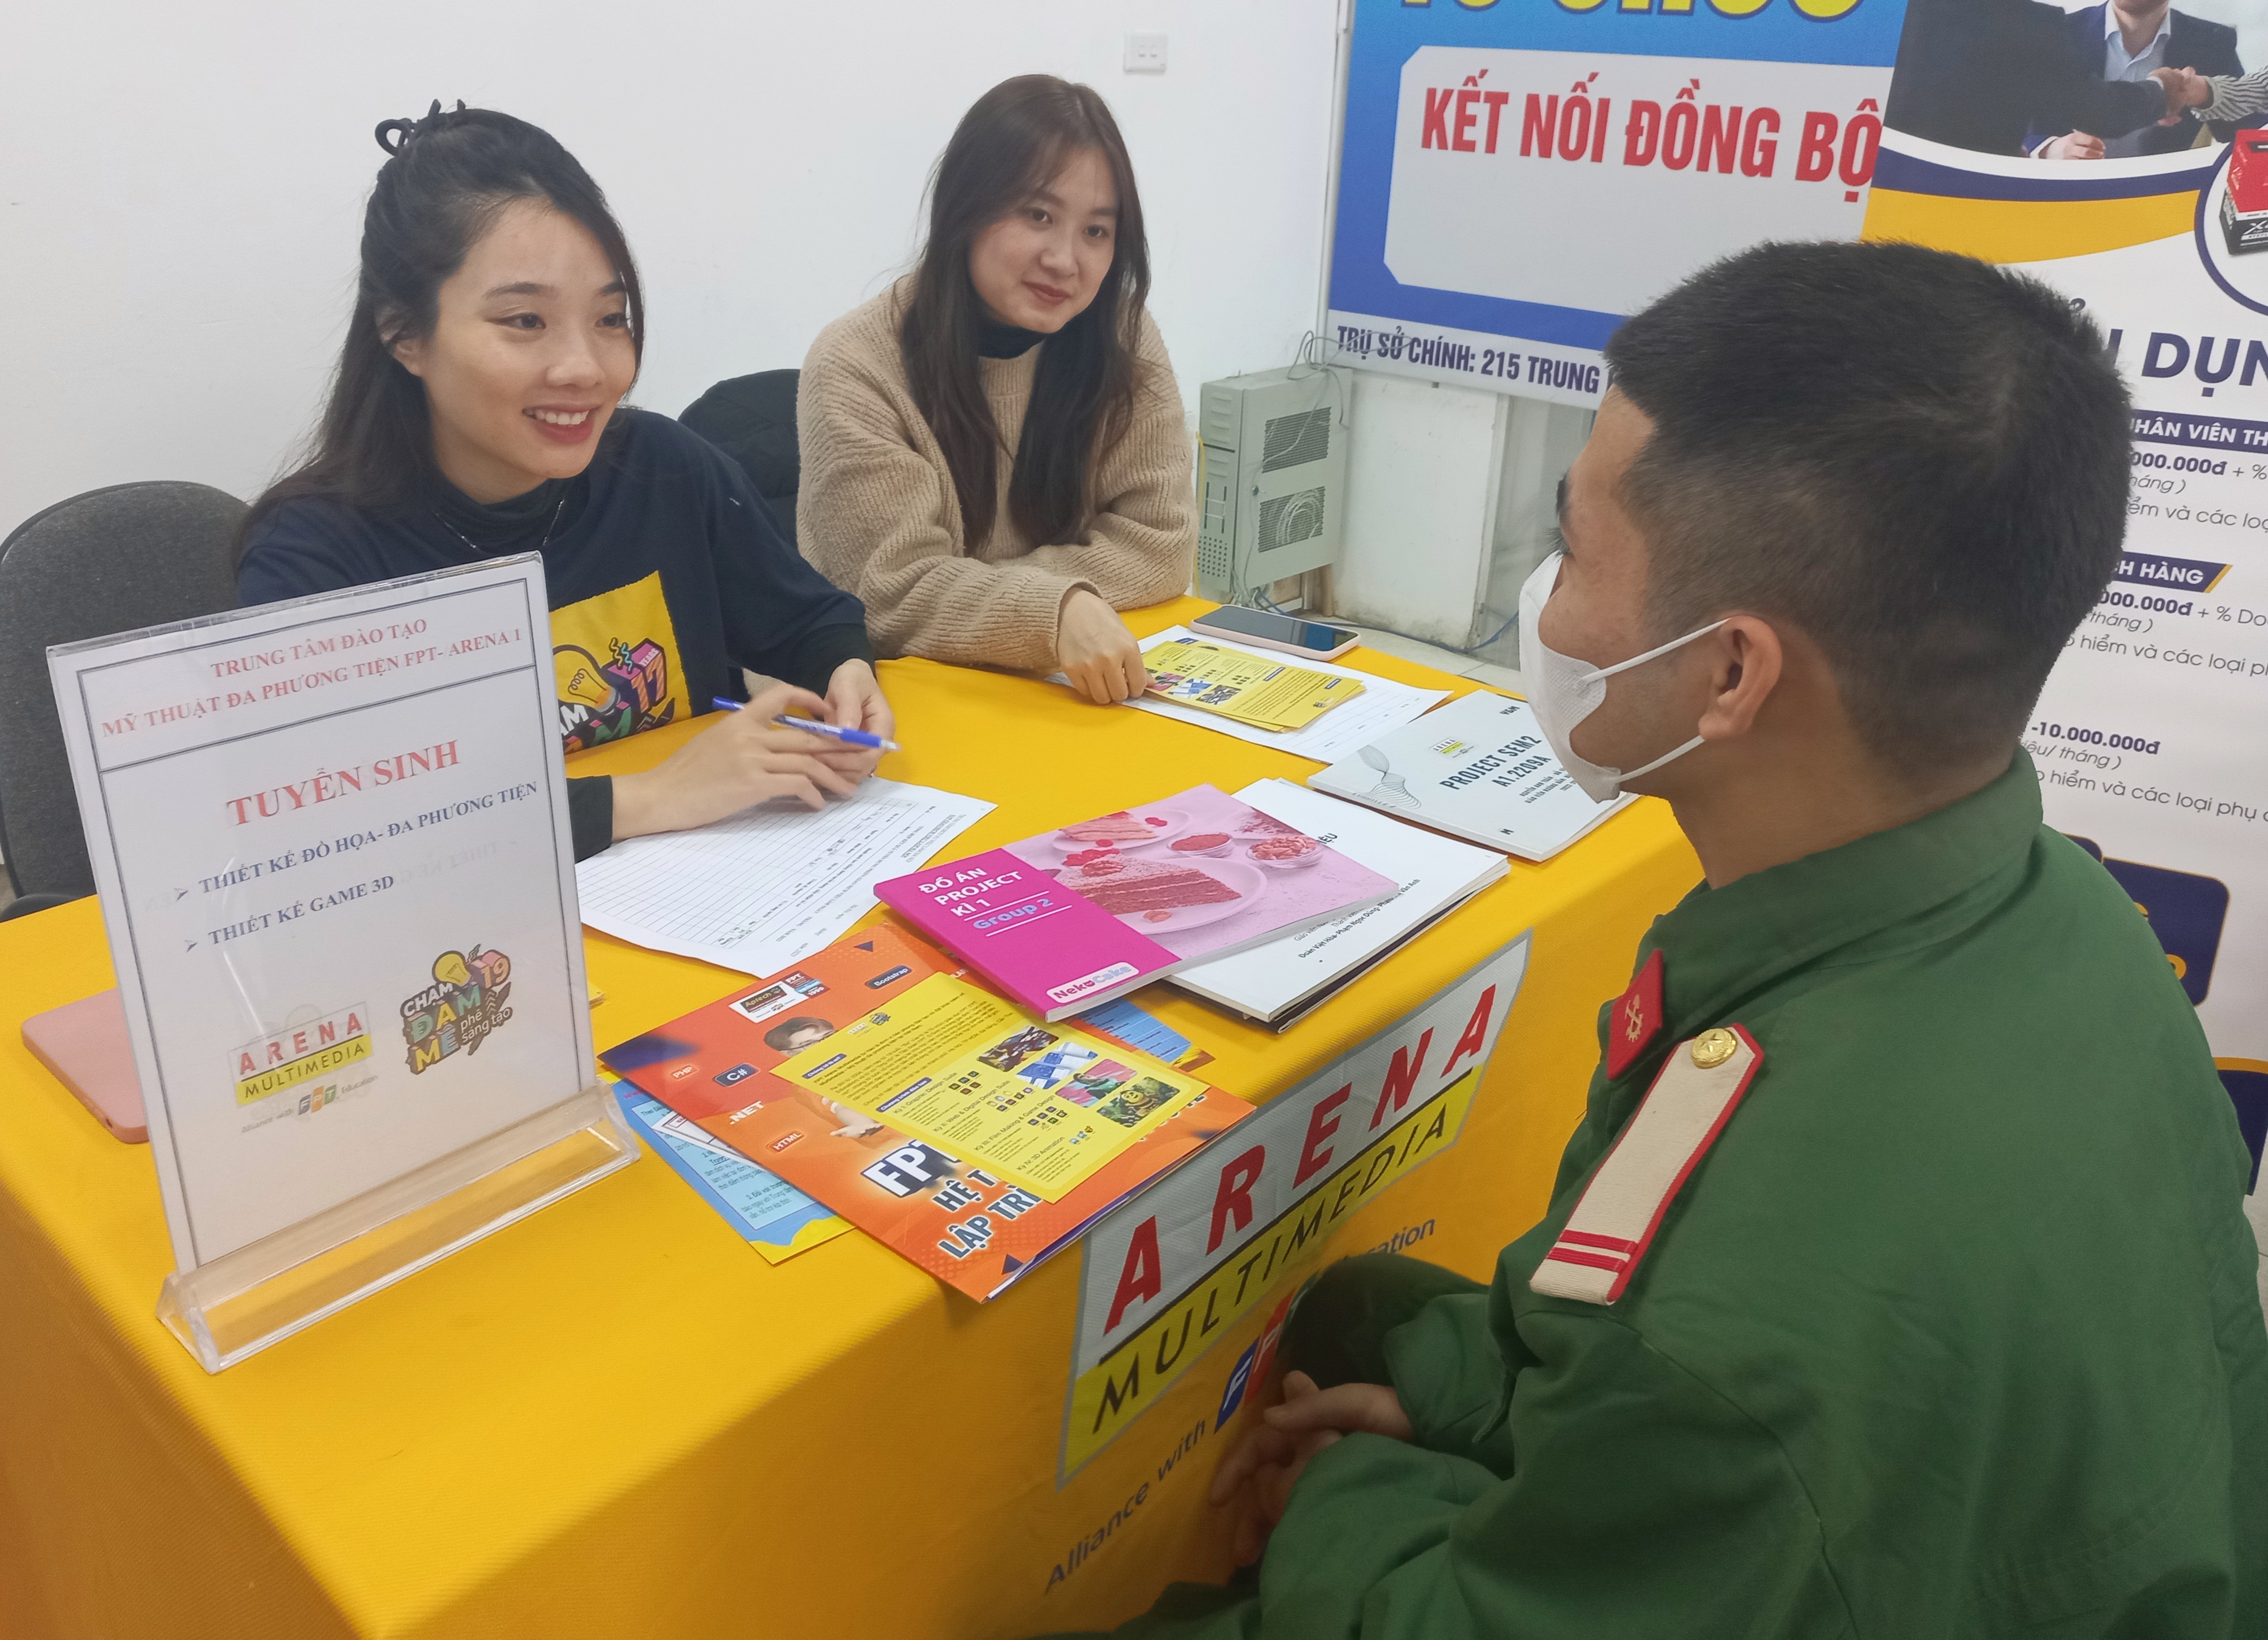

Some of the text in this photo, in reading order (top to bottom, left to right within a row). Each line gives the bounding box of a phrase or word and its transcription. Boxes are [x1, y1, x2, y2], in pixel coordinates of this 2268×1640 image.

[1420, 68, 1883, 203] KẾT NỐI ĐỒNG BỘ
[1338, 326, 1601, 394] TRỤ SỞ CHÍNH: 215 TRUNG
[2188, 422, 2236, 443] VIÊN
[2253, 464, 2267, 480] %
[2166, 505, 2237, 526] và các
[2139, 561, 2204, 584] HÀNG
[2217, 605, 2232, 622] %
[2238, 609, 2268, 626] Do
[211, 618, 427, 678] TRUNG TÂM ĐÀO TẠO
[2080, 634, 2246, 674] hiểm và các loại
[101, 712, 137, 737] MỸ
[144, 696, 220, 726] THUẬT
[227, 691, 257, 708] ĐA
[262, 666, 348, 700] PHƯƠNG
[353, 656, 400, 679] TIỆN
[448, 631, 509, 656] ARENA
[514, 628, 523, 641] 1
[1439, 754, 1507, 790] PROJECT
[1497, 736, 1543, 757] SEM2
[1492, 755, 1552, 787] A1.2209A
[2059, 748, 2110, 769] tháng
[226, 739, 460, 826] TUYỂN SINH
[2050, 770, 2096, 791] hiểm
[2102, 781, 2126, 796] và
[2131, 787, 2171, 803] các
[2176, 792, 2212, 813] loại
[2216, 802, 2257, 822] phụ
[198, 863, 262, 894] THIẾT
[269, 849, 298, 873] KẾ
[387, 820, 414, 838] ĐA
[417, 794, 494, 828] PHƯƠNG
[497, 781, 538, 803] TIỆN
[1318, 832, 1338, 845] IỆU
[918, 867, 987, 895] ĐỒ ÁN
[933, 871, 1023, 906] PROJECT
[208, 875, 394, 945] THIẾT KẾ GAME 3D
[950, 898, 992, 917] KÌ 1
[973, 898, 1054, 930] Group 2
[403, 957, 509, 1017] CHẠM 19
[785, 973, 802, 984] FPT
[873, 968, 909, 987] Bootstrap
[411, 984, 481, 1043] ĐAM
[744, 992, 772, 1008] Aptech
[460, 1009, 483, 1033] phê
[462, 1008, 510, 1043] sáng tạo
[240, 1012, 362, 1076] ARENA
[415, 1023, 459, 1072] MÊ
[245, 1043, 364, 1099] MULTIMEDIA
[672, 1065, 694, 1079] PHP
[727, 1067, 748, 1082] C#
[904, 1091, 928, 1106] Graphic
[925, 1080, 946, 1093] Design
[942, 1071, 958, 1081] Suite
[729, 1100, 765, 1125] .NET
[945, 1113, 961, 1123] Web
[962, 1100, 983, 1112] Digital
[978, 1088, 1000, 1101] Design
[995, 1079, 1011, 1089] Suite
[988, 1131, 1003, 1140] Film
[999, 1119, 1021, 1133] Making
[1021, 1105, 1039, 1117] Game
[1036, 1094, 1057, 1107] Design
[773, 1131, 803, 1151] HTML
[1038, 1135, 1066, 1154] Animation
[1103, 983, 1496, 1336] ARENA
[932, 1179, 982, 1212] HỆ
[938, 1184, 1042, 1259] LẬP TRÌ
[1092, 1104, 1448, 1435] MULTIMEDIA
[1044, 1218, 1436, 1596] Alliance with ation
